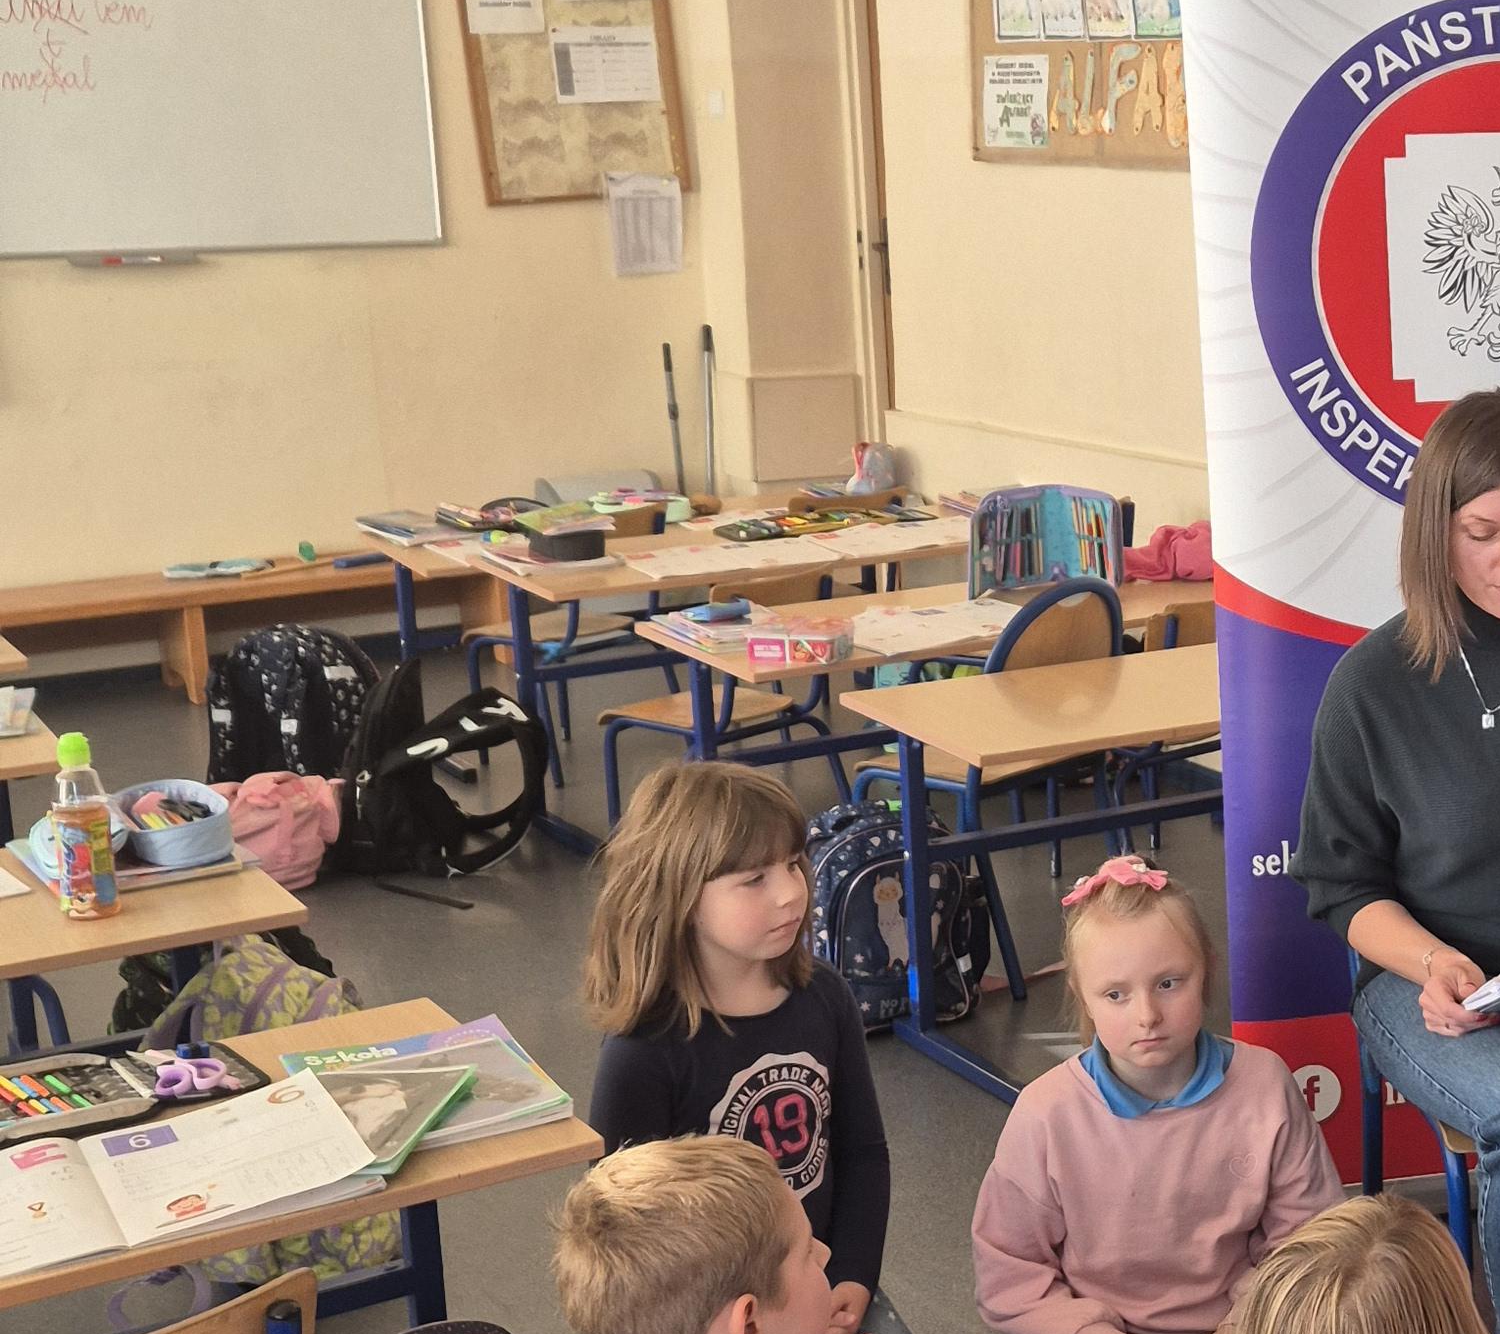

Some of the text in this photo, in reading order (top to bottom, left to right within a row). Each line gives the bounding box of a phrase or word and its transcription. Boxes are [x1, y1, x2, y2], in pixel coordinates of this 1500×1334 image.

[303, 1046, 399, 1066] Szkoła
[722, 1086, 757, 1136] IGINAL
[757, 1066, 811, 1086] TRADE
[128, 1133, 151, 1149] 6
[753, 1092, 809, 1160] 19
[801, 1137, 830, 1185] GOODS
